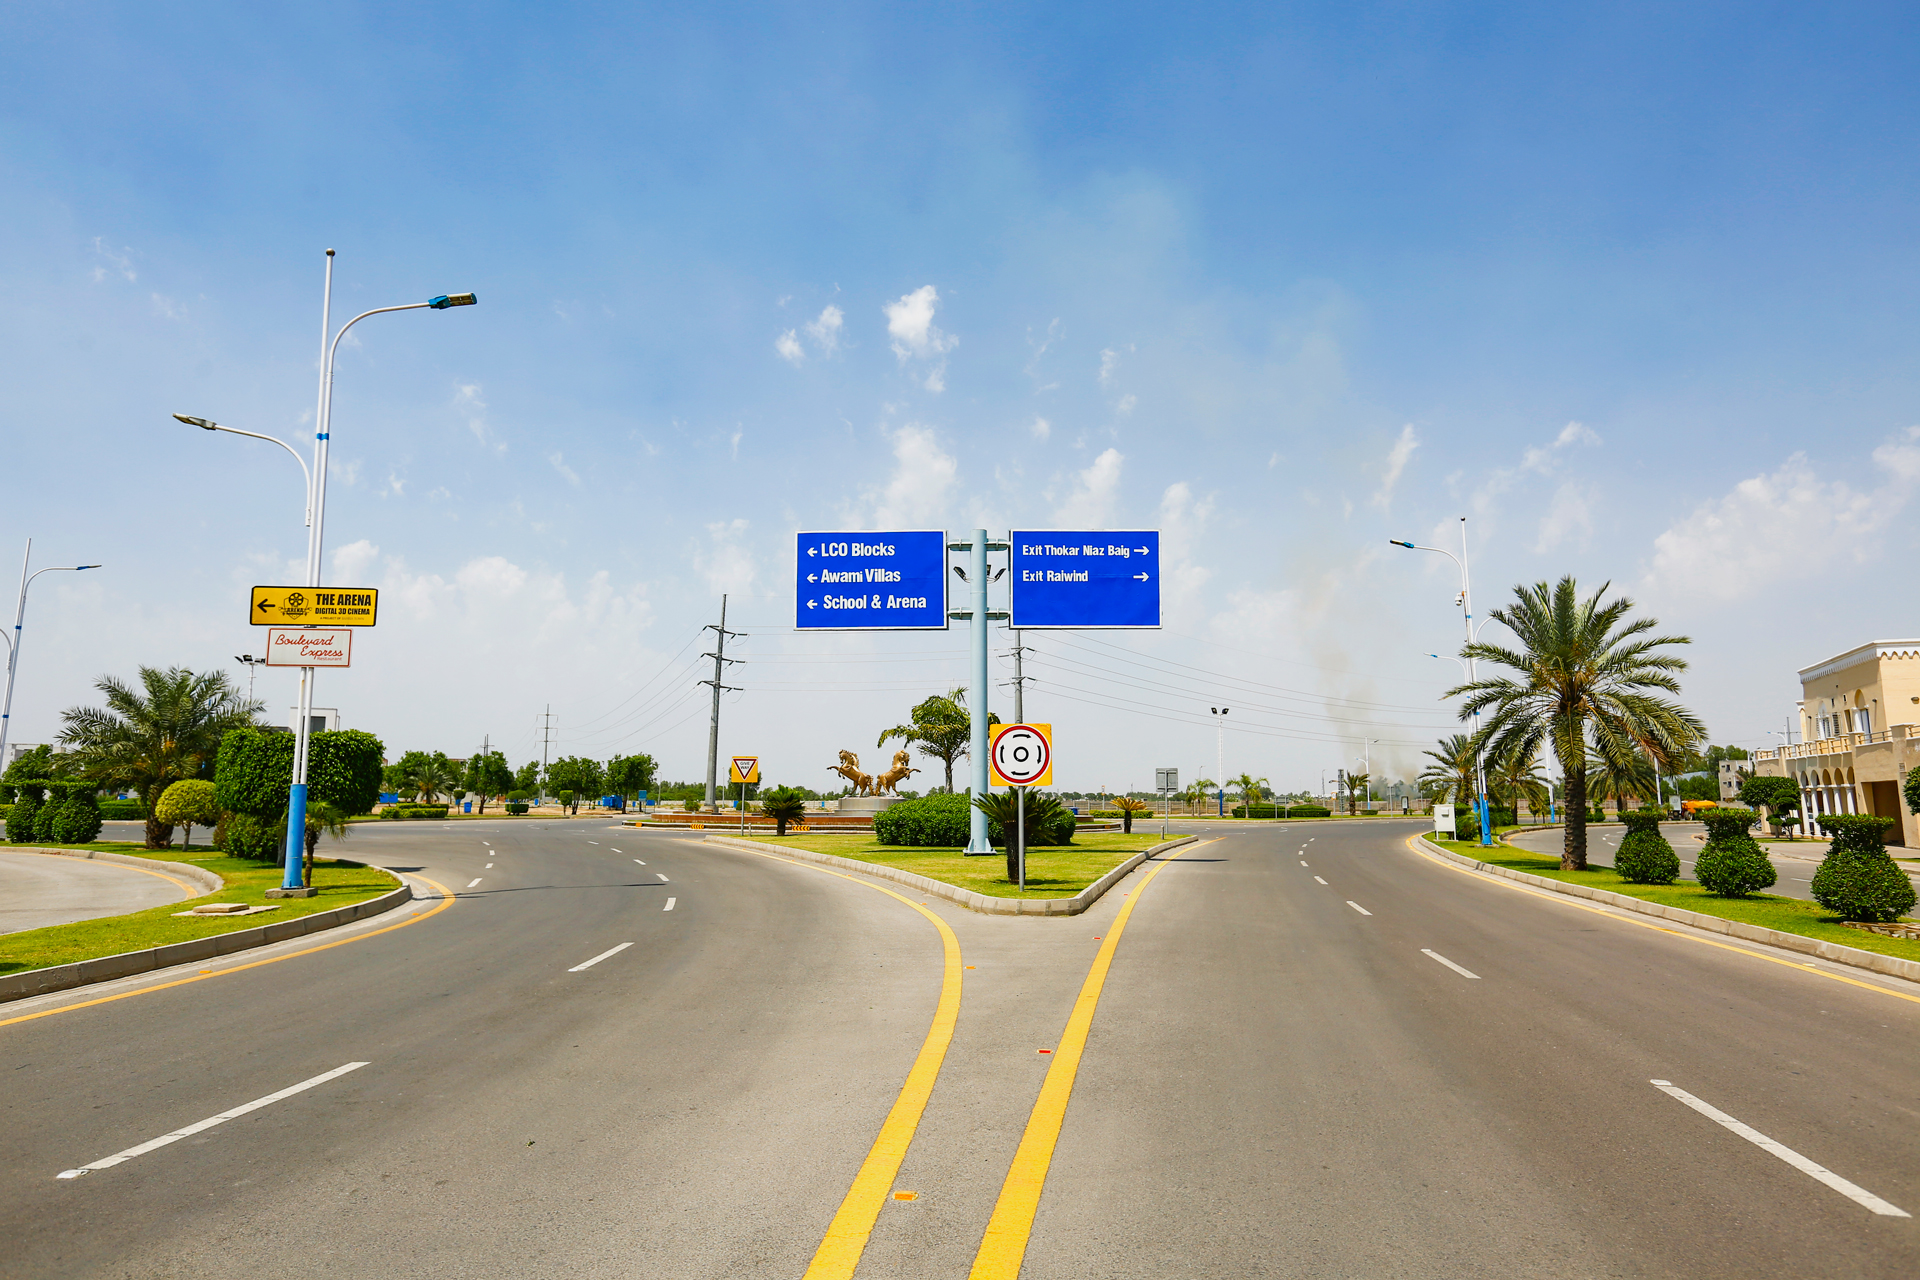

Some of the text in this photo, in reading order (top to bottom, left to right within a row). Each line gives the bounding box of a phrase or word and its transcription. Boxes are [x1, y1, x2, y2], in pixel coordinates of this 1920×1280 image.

[821, 542, 896, 557] LCO Blocks
[1022, 545, 1130, 559] Exit Thokar Niaz Baig
[820, 568, 901, 583] Awami Villas
[1022, 569, 1089, 582] Exit Raiwind
[316, 593, 372, 606] THE ARENA
[823, 594, 927, 609] School & Arena
[315, 607, 370, 616] DIGITAL 3D CINEMA
[275, 633, 335, 646] Boulevard
[300, 645, 344, 660] Express
